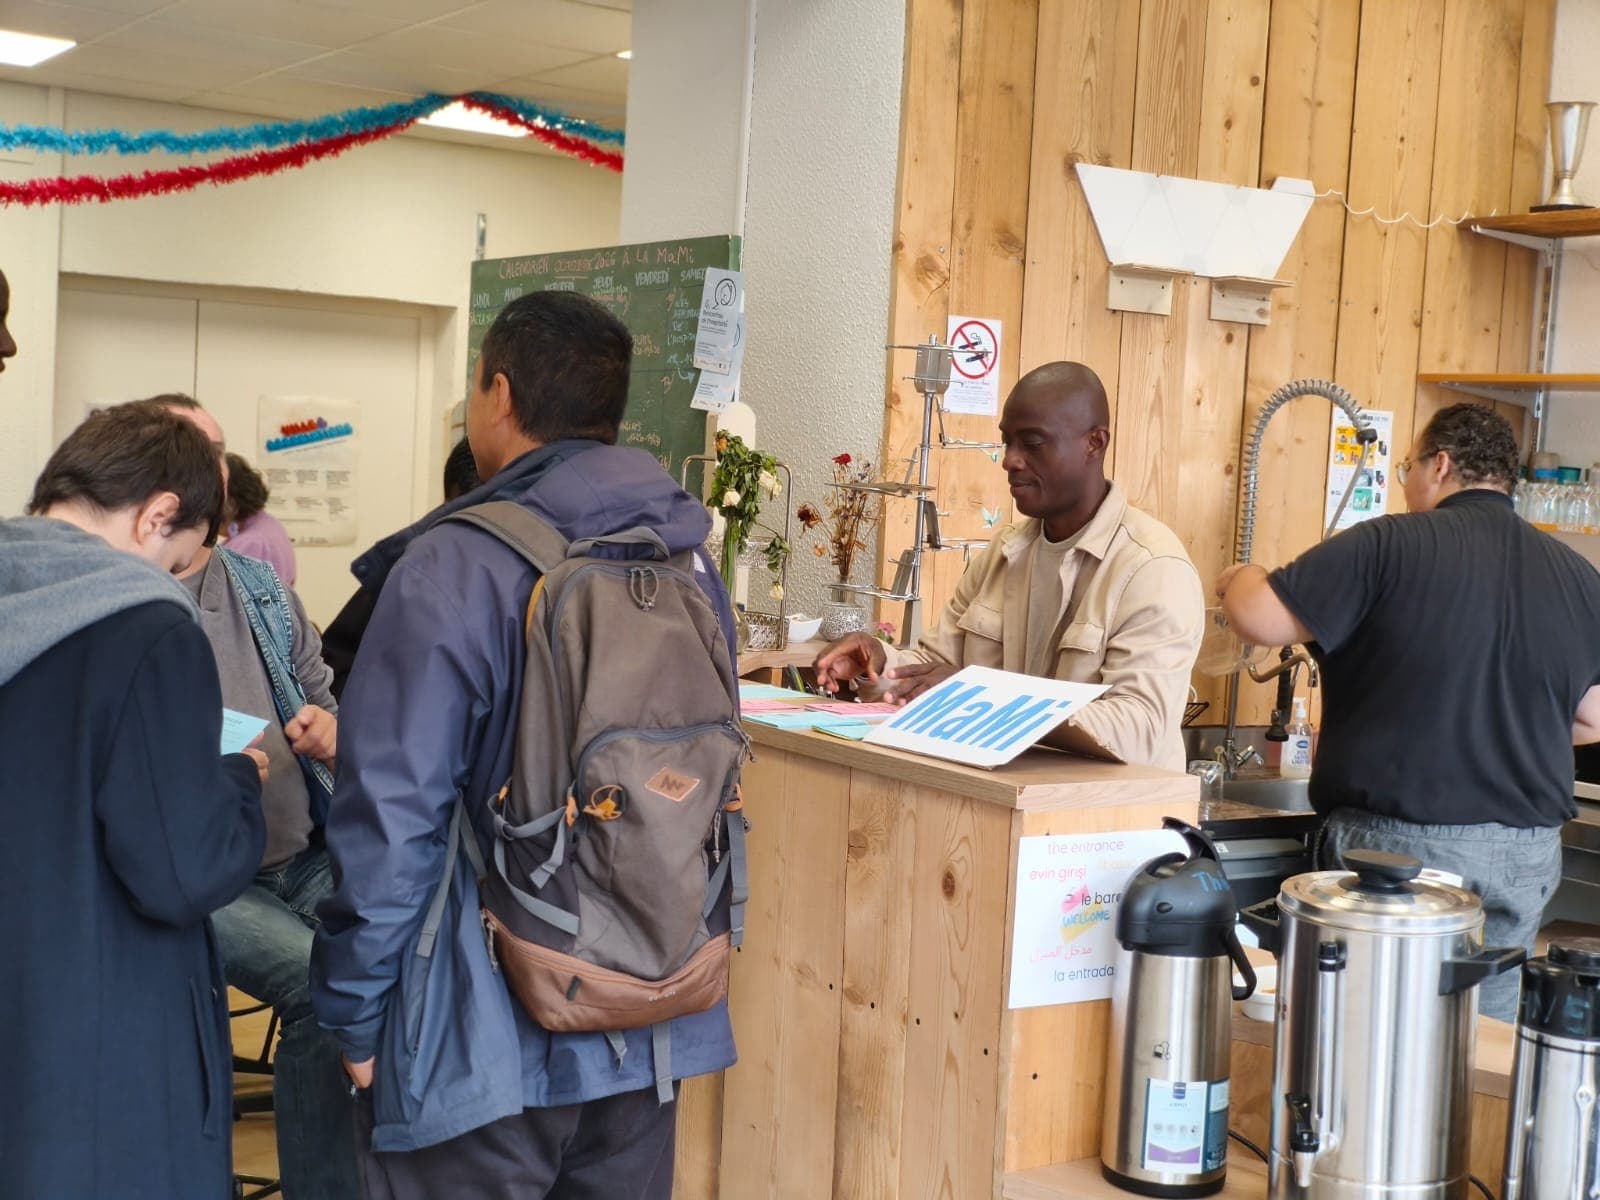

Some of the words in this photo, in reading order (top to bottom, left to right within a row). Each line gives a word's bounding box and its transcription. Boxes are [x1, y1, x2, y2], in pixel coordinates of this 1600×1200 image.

[656, 245, 695, 265] MaMi
[680, 266, 707, 282] SAMED
[889, 680, 1073, 752] MaMi
[1070, 839, 1125, 854] entrance
[1029, 865, 1055, 880] evin
[1081, 892, 1092, 906] le
[1054, 969, 1065, 983] la
[1068, 964, 1115, 981] entrada
